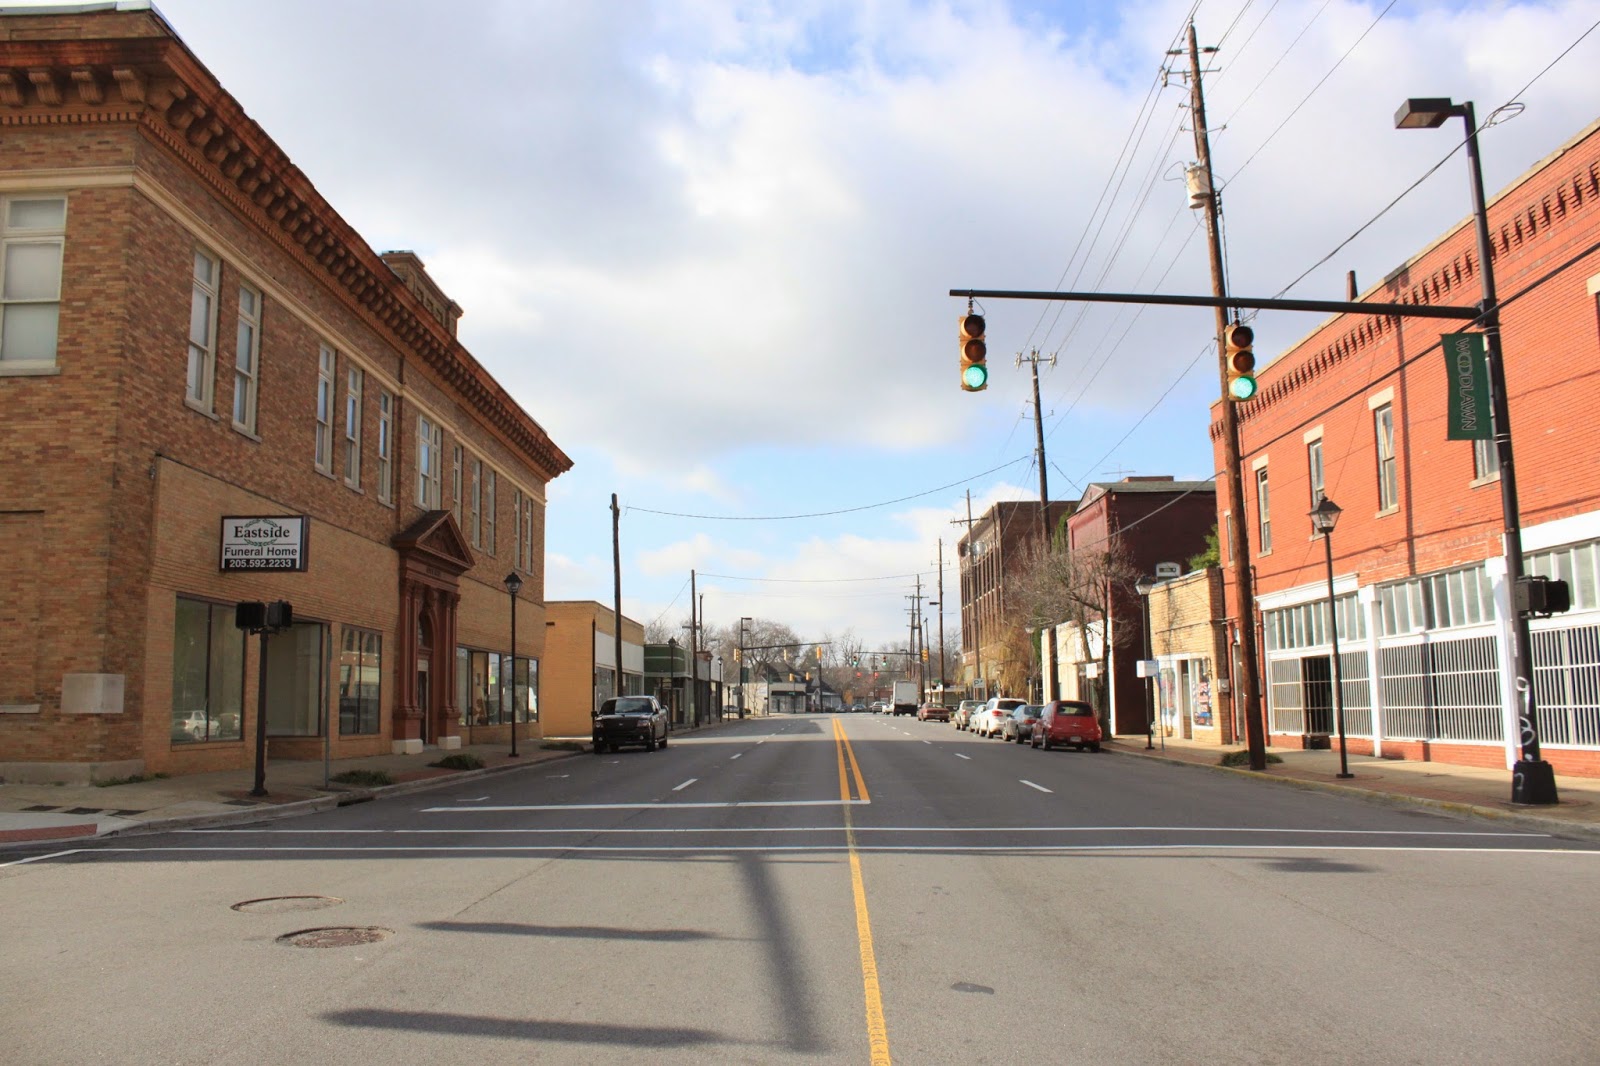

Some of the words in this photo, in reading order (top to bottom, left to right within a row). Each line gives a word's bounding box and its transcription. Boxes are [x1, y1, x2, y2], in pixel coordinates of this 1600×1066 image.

[1456, 337, 1477, 431] WOODLAWN
[234, 525, 290, 538] Eastside
[224, 547, 263, 556] Funeral
[266, 547, 297, 556] Home
[229, 559, 292, 568] 205.592.2233
